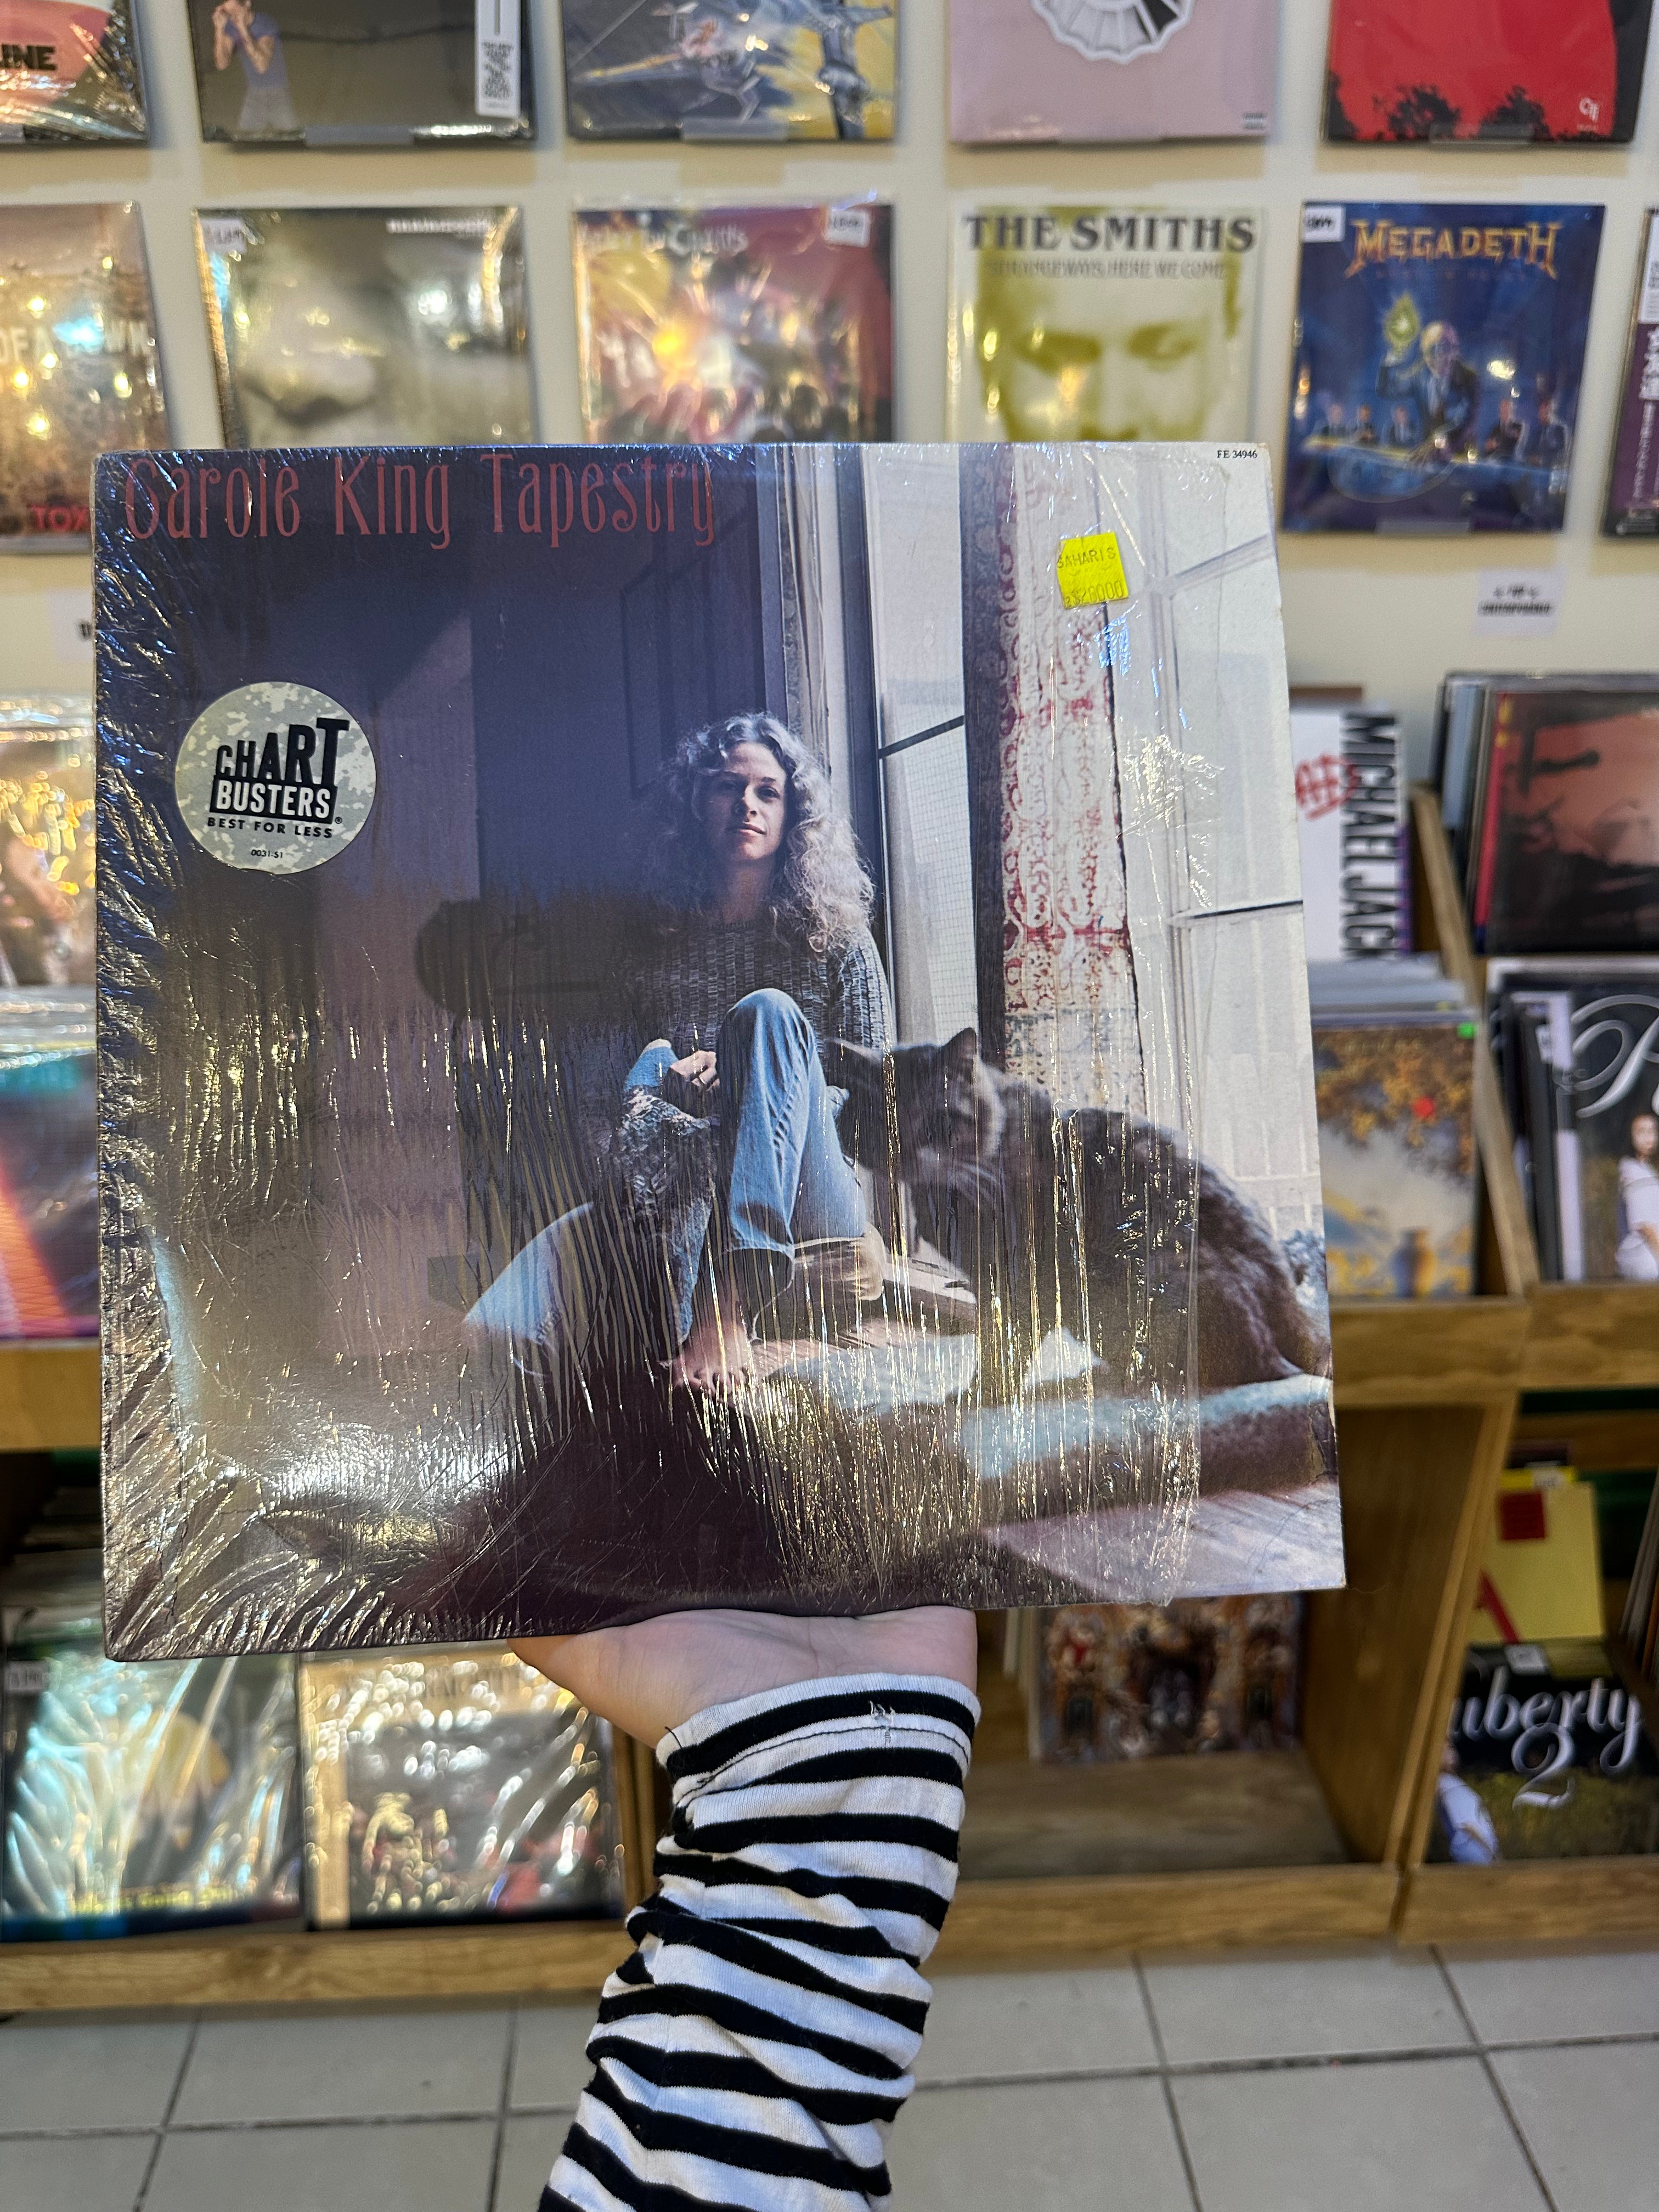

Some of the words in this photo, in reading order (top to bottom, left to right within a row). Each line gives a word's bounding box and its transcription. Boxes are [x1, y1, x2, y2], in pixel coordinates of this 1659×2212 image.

[964, 216, 1062, 251] THE
[1069, 216, 1256, 252] SMITHS
[1345, 219, 1562, 280] MEGADETH
[1217, 450, 1230, 459] FE
[1232, 450, 1257, 459] 34946
[125, 457, 301, 540] Carole
[334, 455, 450, 550] King
[479, 454, 714, 548] Tapestry
[215, 717, 350, 786] CHART
[216, 780, 331, 819] BUSTERS
[1342, 714, 1397, 870] MICHAEL
[207, 817, 246, 830] BEST
[254, 821, 286, 834] FOR
[295, 825, 333, 839] LESS
[250, 849, 284, 859] 0031-S1
[1447, 1664, 1643, 1776] uberty
[1511, 1722, 1576, 1811] 2
